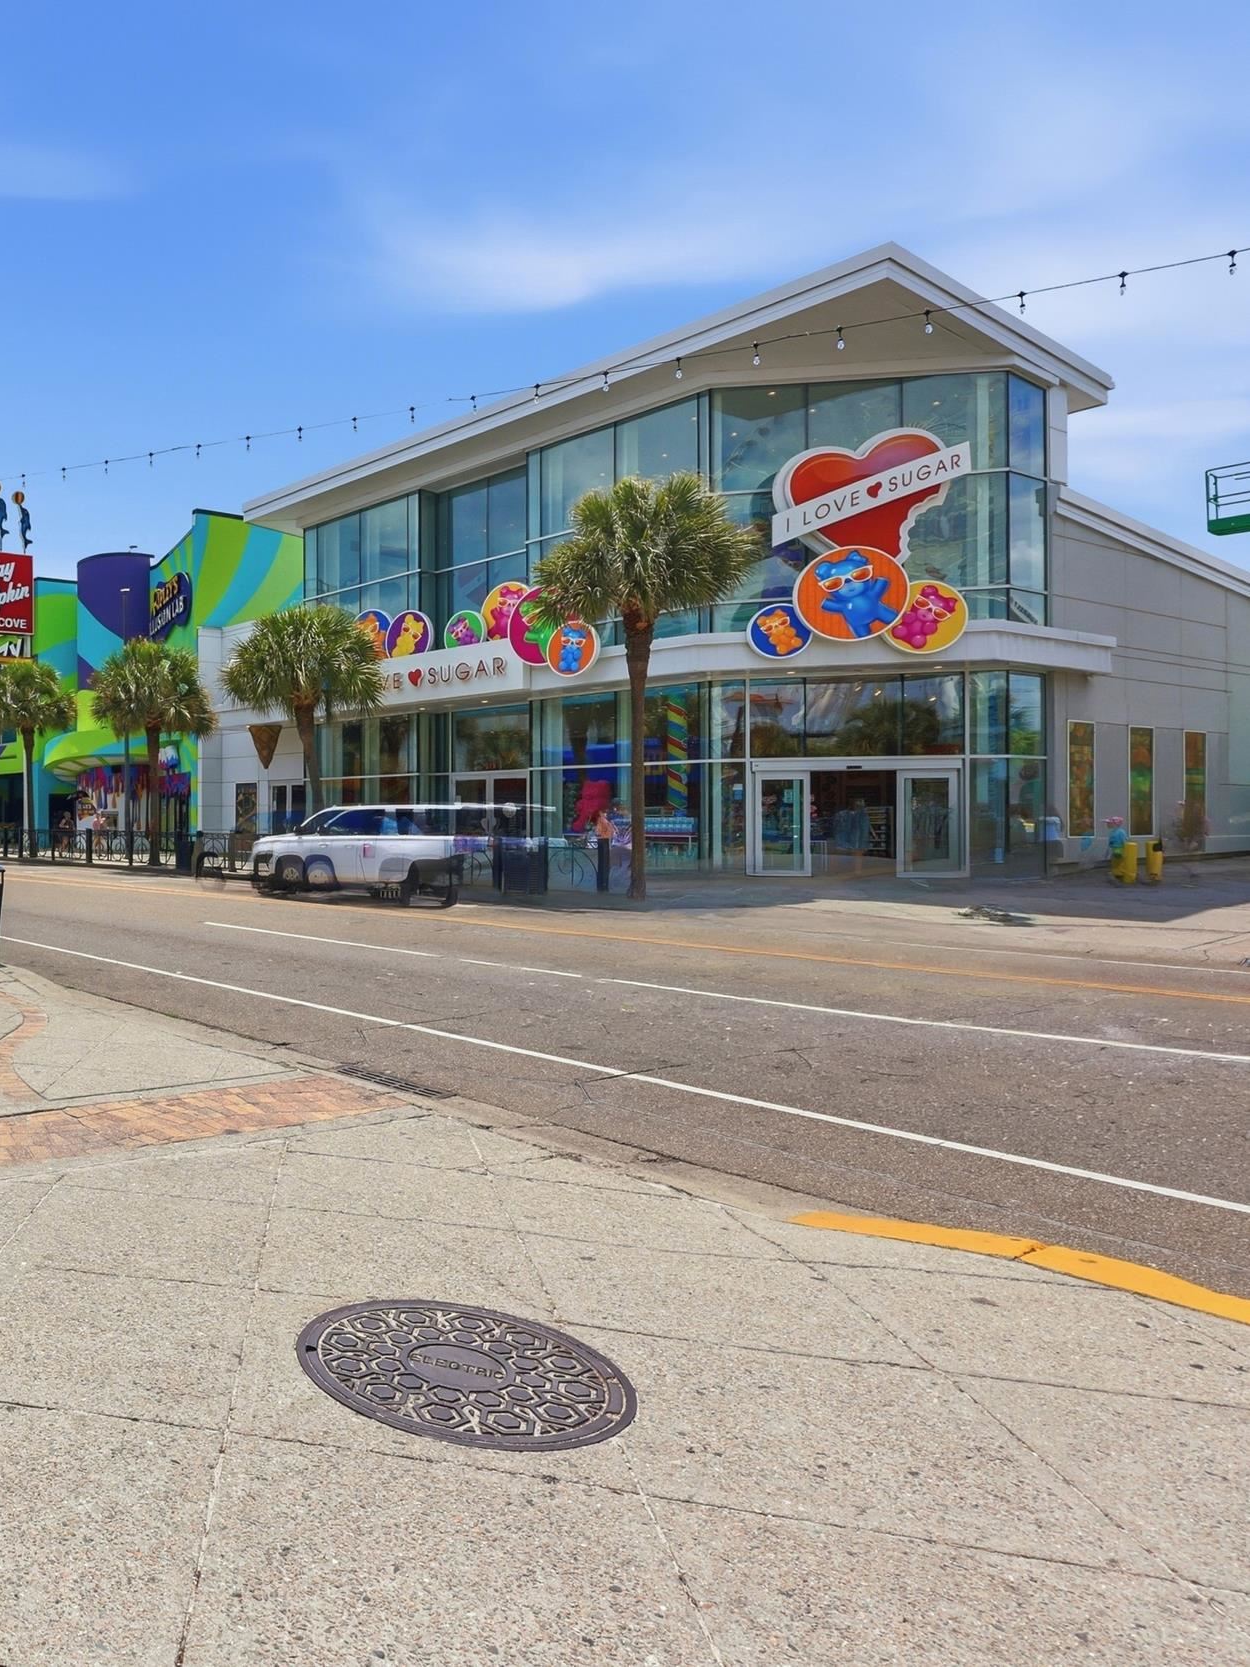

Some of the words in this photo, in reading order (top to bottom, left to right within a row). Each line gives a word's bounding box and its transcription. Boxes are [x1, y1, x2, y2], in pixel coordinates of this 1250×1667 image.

[786, 518, 790, 532] I
[803, 490, 860, 526] LOVE
[888, 454, 961, 492] SUGAR
[428, 657, 507, 685] SUGAR
